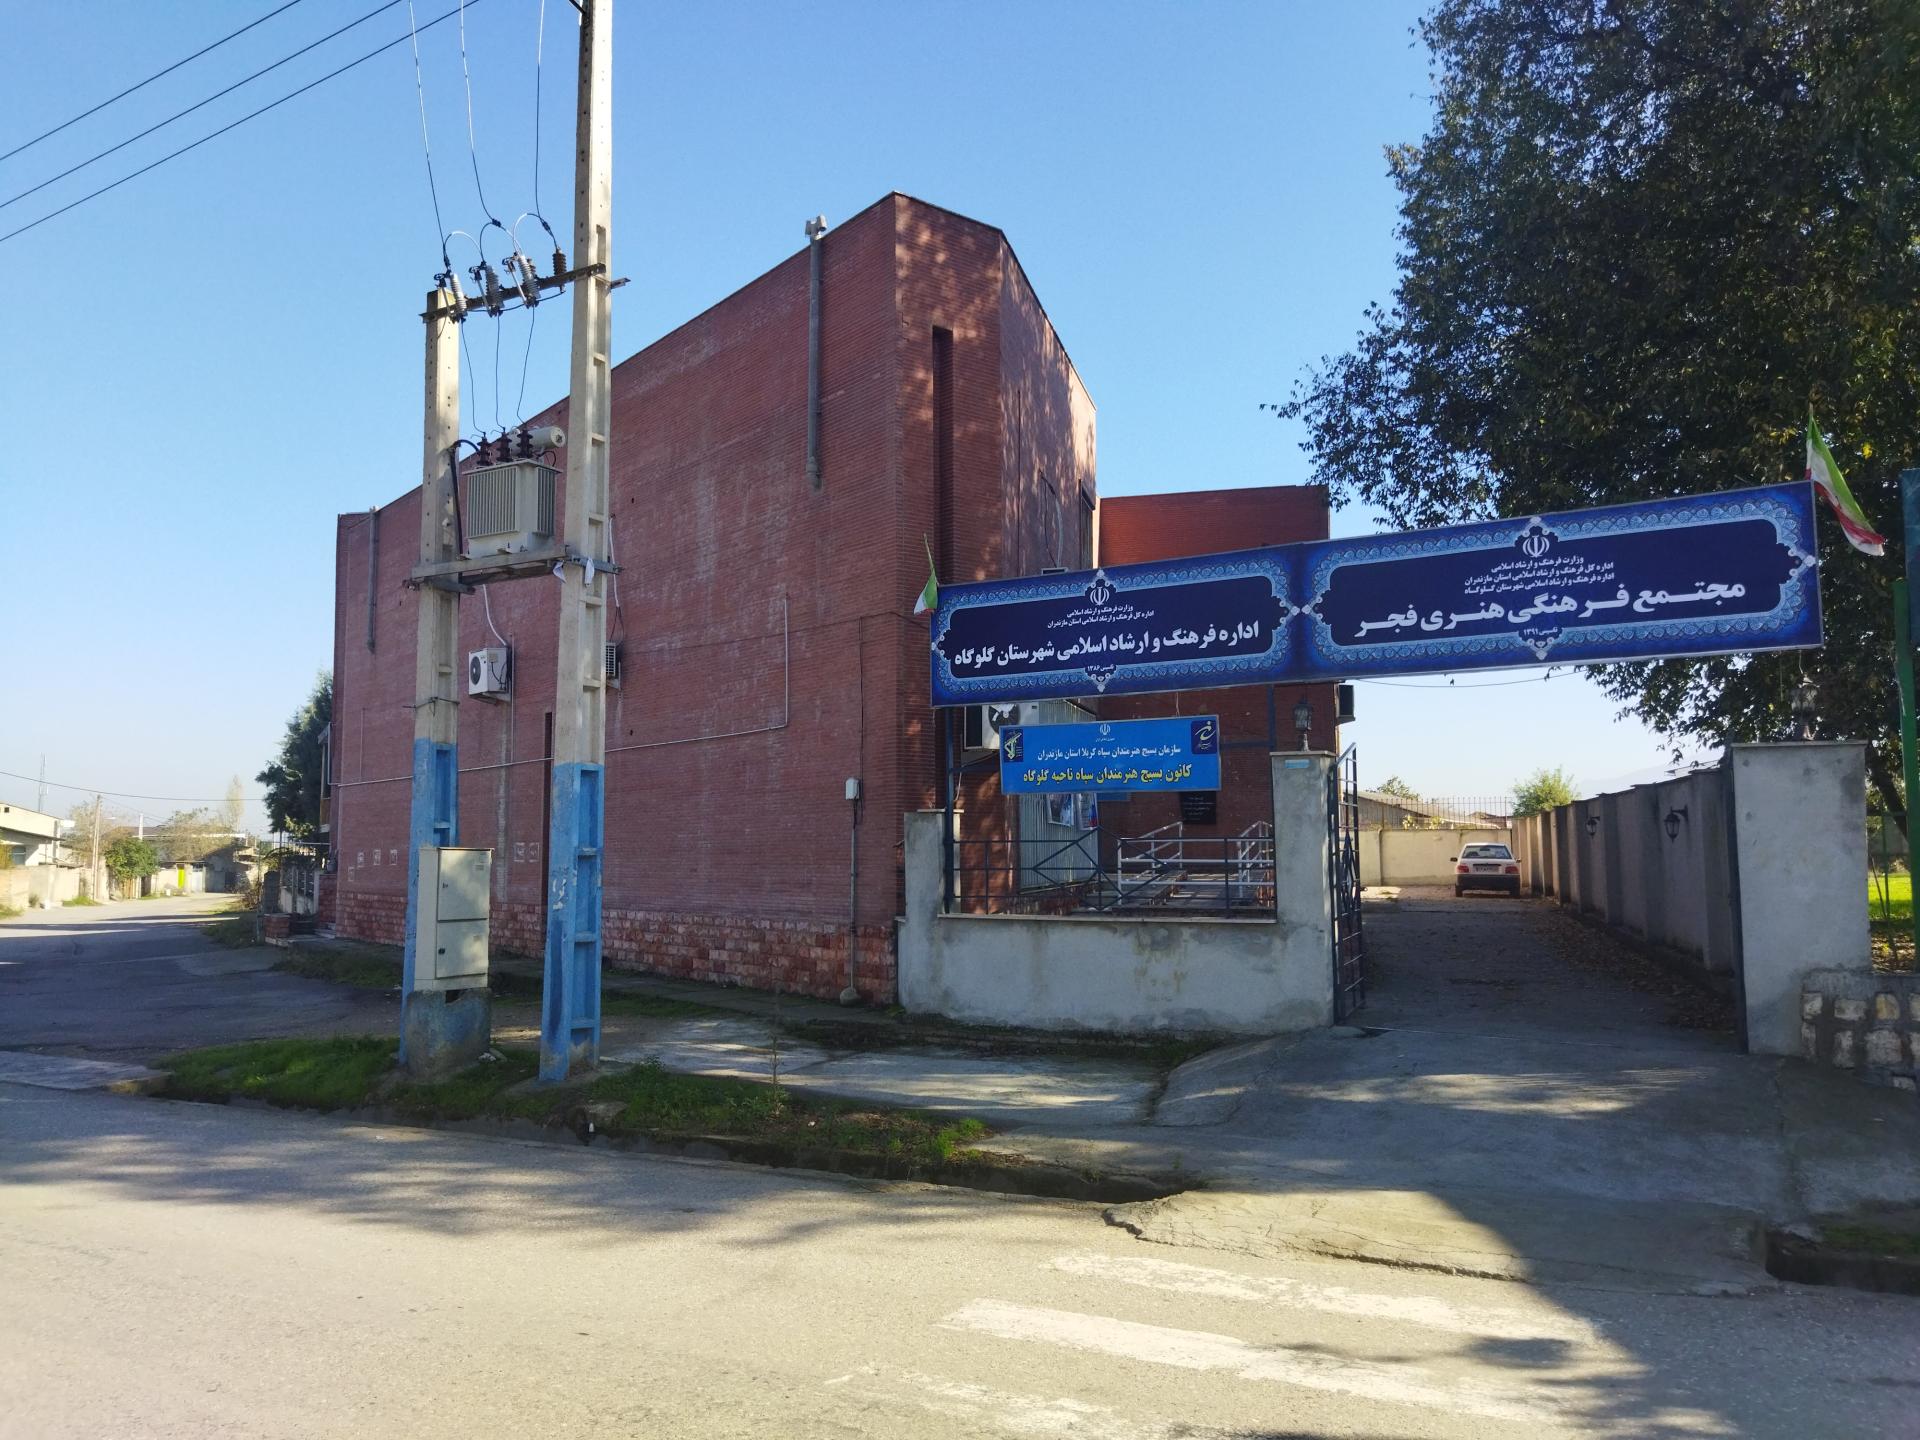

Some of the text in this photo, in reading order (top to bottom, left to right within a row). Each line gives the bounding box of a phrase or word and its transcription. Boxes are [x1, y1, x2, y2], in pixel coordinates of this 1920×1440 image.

[1515, 560, 1532, 569] ارشاد
[1539, 556, 1561, 566] فرهنگ
[1563, 555, 1584, 565] وزارت
[1491, 562, 1514, 573] اسلامی
[1560, 564, 1583, 574] فرهنگ
[1585, 563, 1595, 573] کل
[1596, 562, 1614, 572] اداره
[1494, 572, 1511, 582] استان
[1512, 570, 1535, 581] اسلامی
[1536, 568, 1554, 577] ارشاد
[1597, 572, 1614, 582] اداره
[1464, 574, 1492, 586] مازندران
[1549, 577, 1567, 586] ارشاد
[1573, 573, 1596, 584] فرهنگ
[1496, 581, 1524, 592] شهرستان
[1525, 578, 1548, 590] اسلامی
[1084, 607, 1097, 615] ارشاد
[1101, 606, 1117, 614] فرهنگ
[1118, 603, 1133, 612] وزارت
[1354, 581, 1746, 637] مجتمع فرهنگی هنری فجر
[1067, 608, 1084, 618] اسلامی
[1116, 612, 1133, 620] فرهنگ
[1133, 611, 1141, 620] کل
[1141, 610, 1154, 619] اداره
[1068, 618, 1081, 626] استان
[1081, 615, 1099, 625] اسلامی
[1099, 614, 1112, 623] ارشاد
[954, 620, 1259, 668] اداره فرهنگ و ارشاد اسلامی شهرستان گلوگاه
[1037, 748, 1063, 760] مازندران
[1064, 748, 1080, 760] استان
[1081, 747, 1097, 759] کربلا
[1112, 746, 1140, 758] هنرمندان
[1142, 747, 1157, 757] بسیج
[1158, 744, 1181, 756] سازمان
[1023, 763, 1192, 785] کانون بسیج هنرمندان سپاه ناحیه گلوگاه
